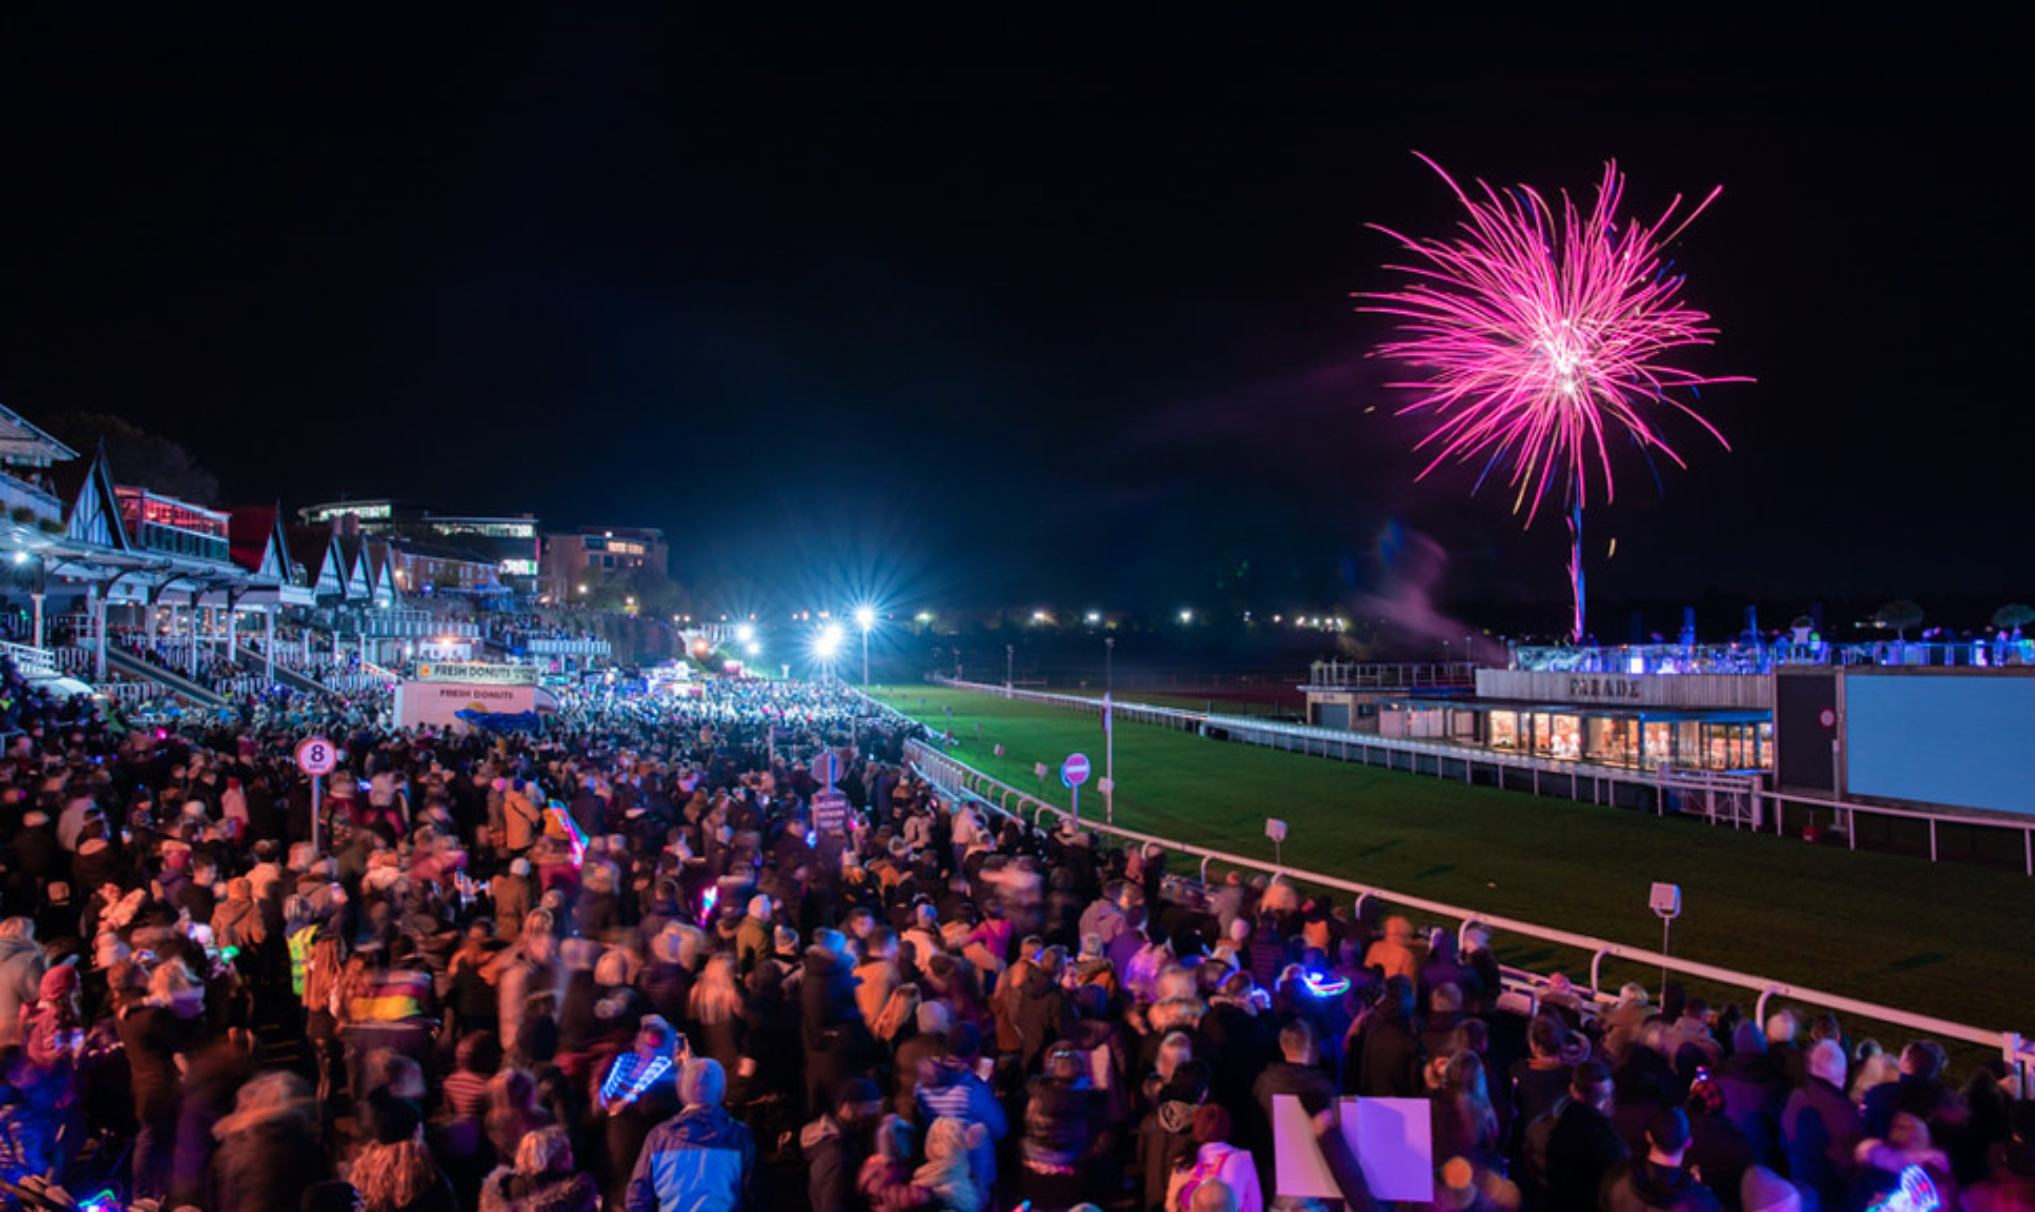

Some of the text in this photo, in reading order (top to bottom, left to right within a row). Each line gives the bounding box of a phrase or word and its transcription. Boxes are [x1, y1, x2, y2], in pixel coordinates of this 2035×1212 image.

[435, 664, 467, 677] FRESH
[469, 666, 511, 678] DONUTS
[440, 689, 514, 699] FRESH DONUTS
[311, 744, 325, 762] 8
